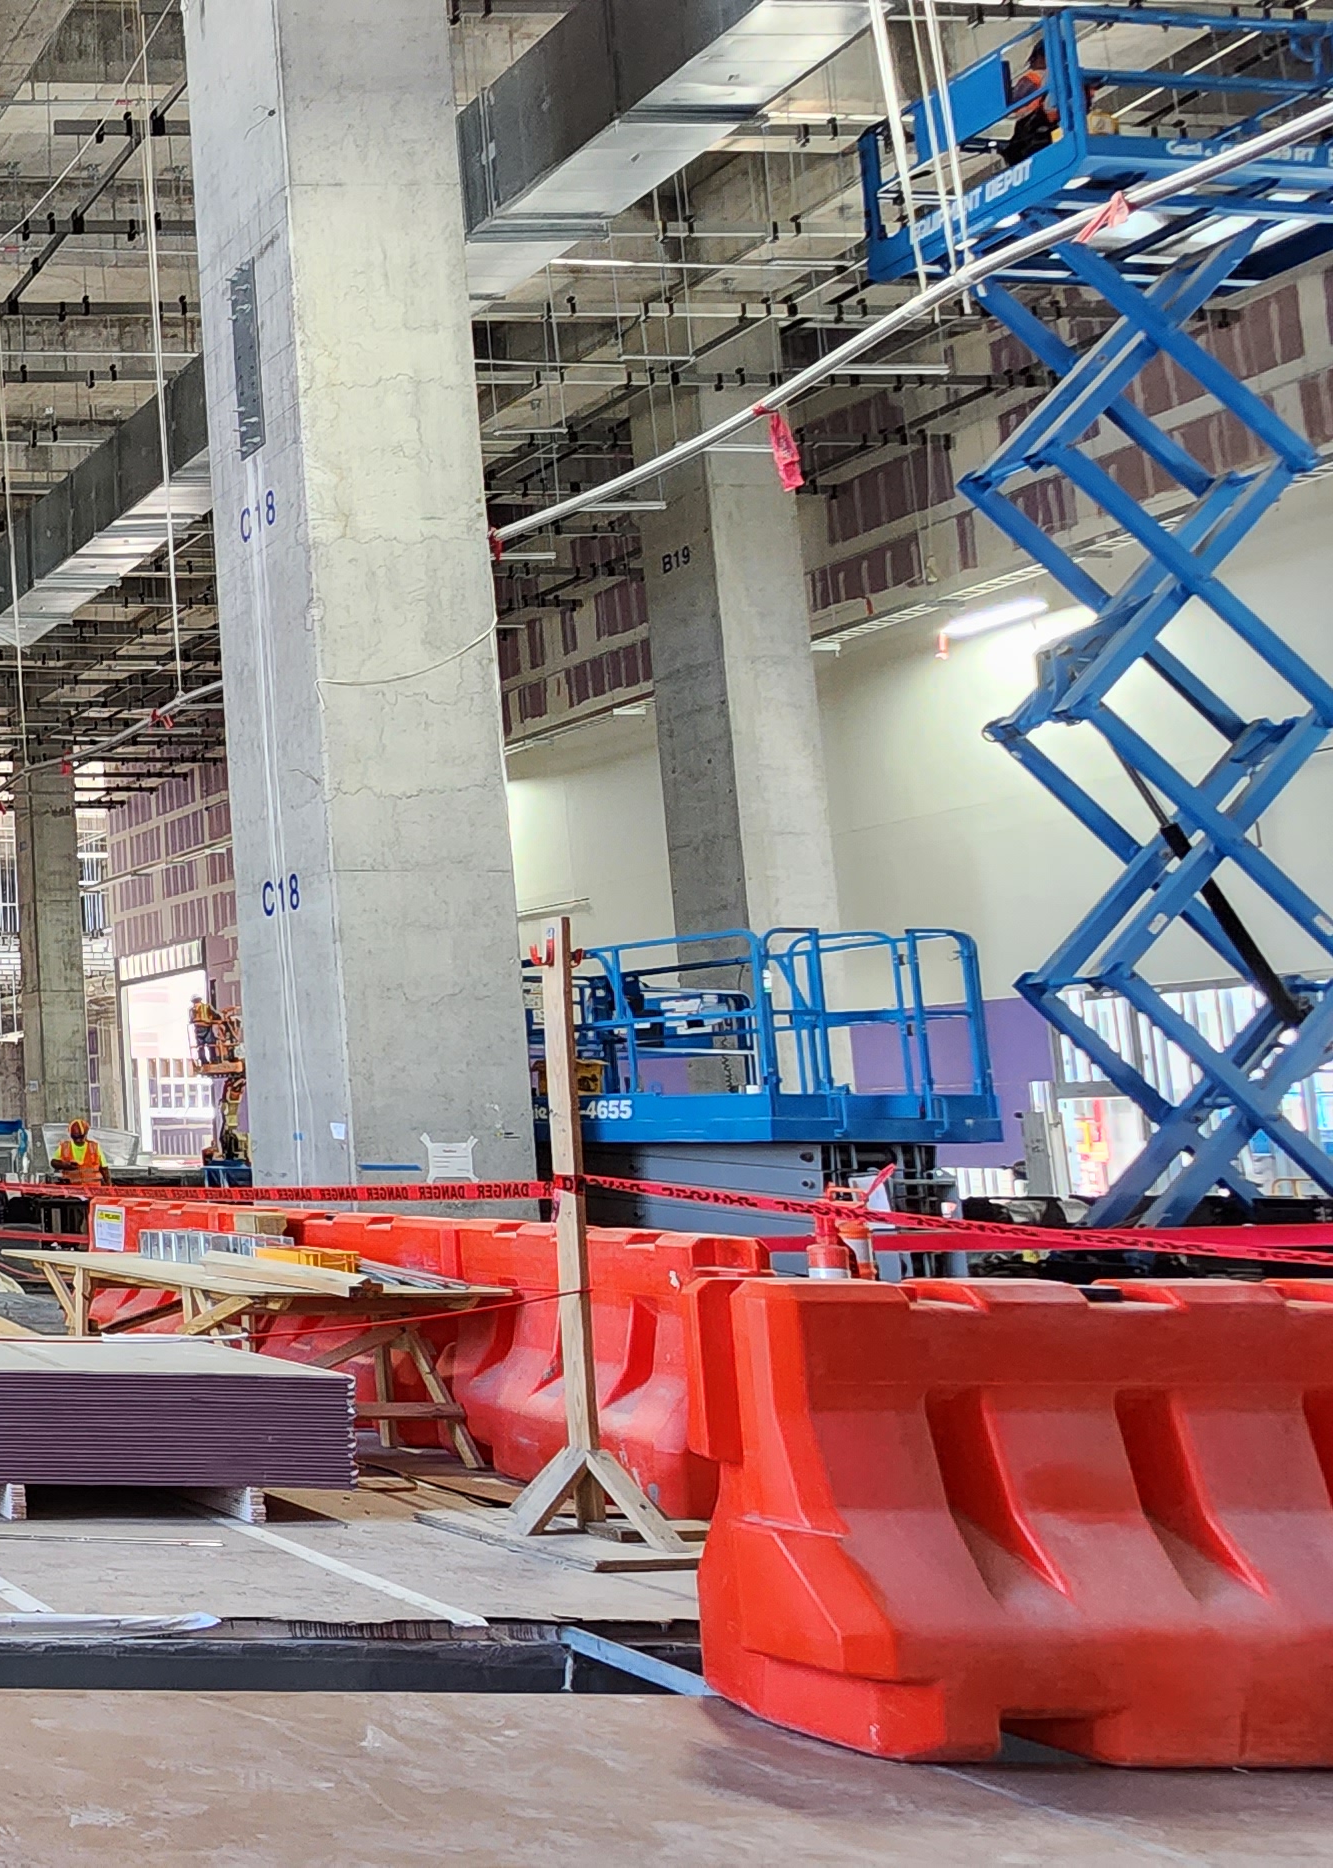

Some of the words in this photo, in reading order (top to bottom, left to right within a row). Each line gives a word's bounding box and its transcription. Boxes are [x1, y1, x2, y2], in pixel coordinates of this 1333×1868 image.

[985, 157, 1034, 202] DEPOT
[240, 490, 276, 543] C18
[662, 545, 690, 574] B19
[262, 873, 300, 917] C18
